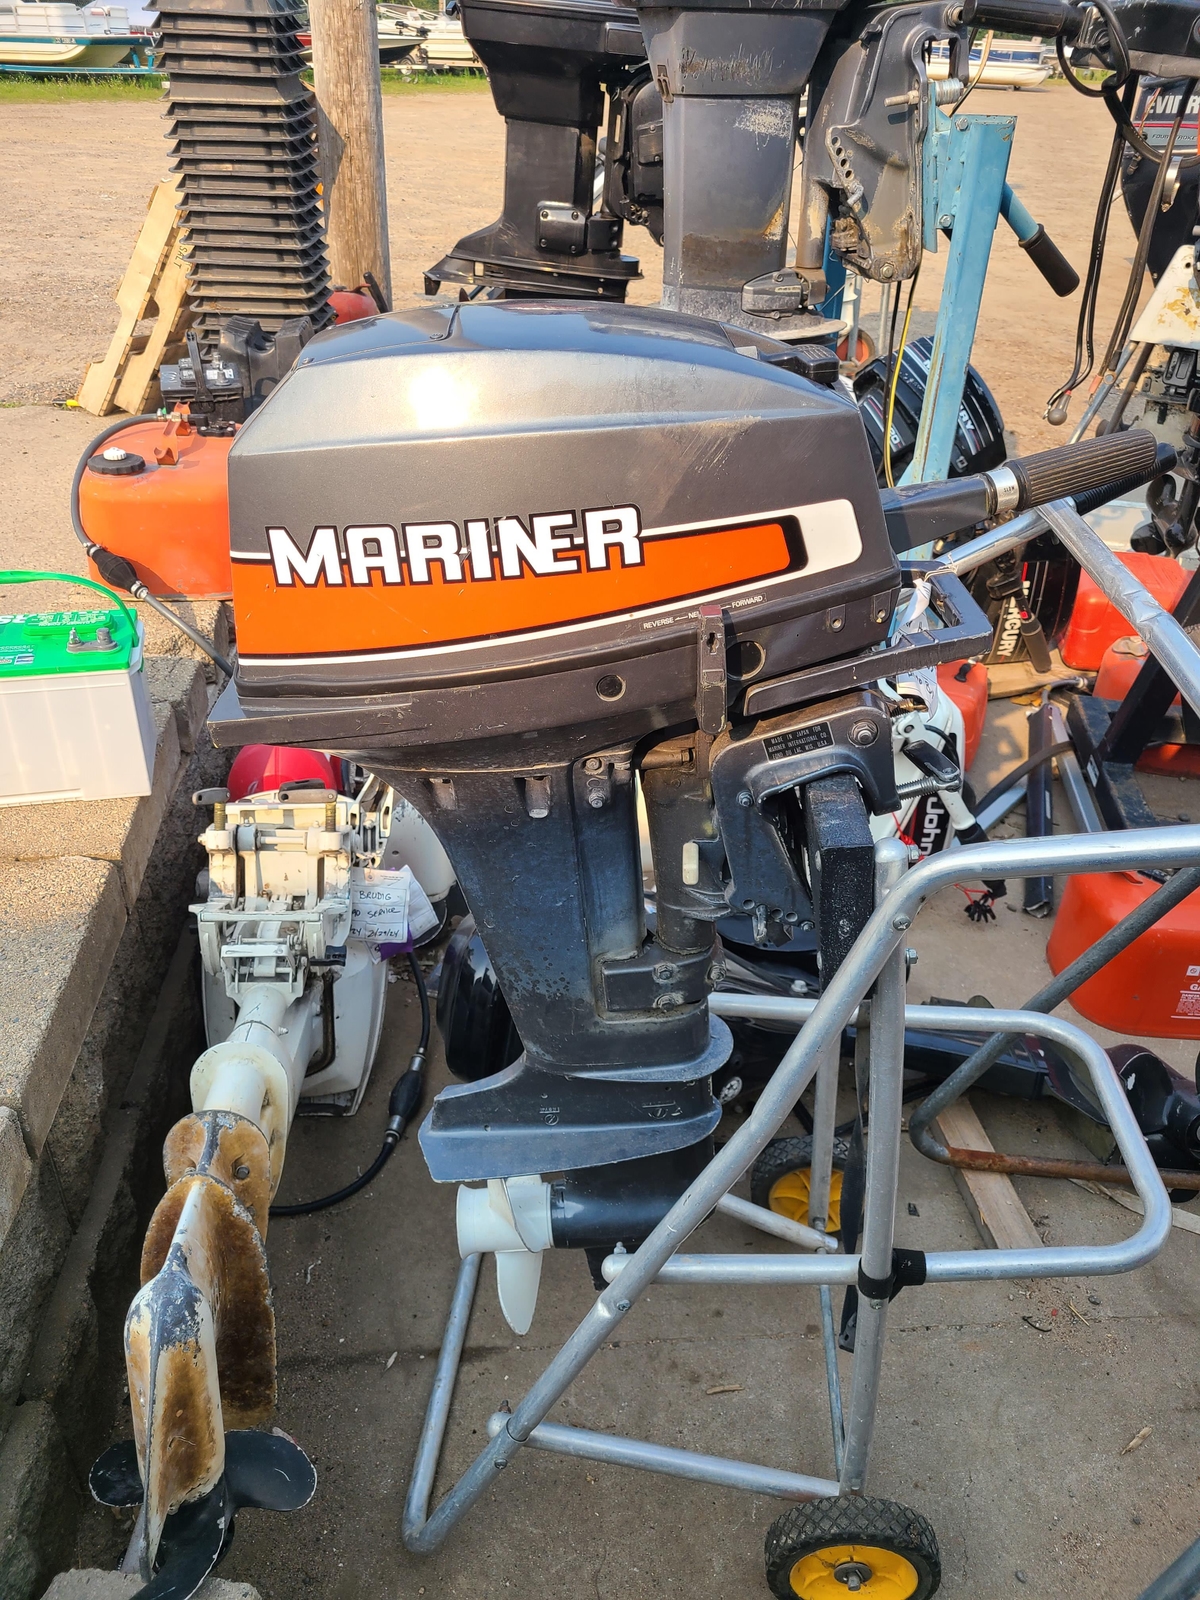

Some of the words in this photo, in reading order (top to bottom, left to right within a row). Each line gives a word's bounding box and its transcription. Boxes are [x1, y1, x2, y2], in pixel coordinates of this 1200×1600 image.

[265, 503, 644, 588] MARINER
[643, 616, 675, 630] REVERSE
[731, 595, 764, 609] FORWARD
[997, 580, 1031, 657] RCURY
[768, 743, 786, 753] MARINER
[787, 734, 819, 748] INTERNATIONAL
[770, 736, 783, 745] MADE
[796, 729, 810, 738] JAPAN
[812, 725, 822, 733] FOR
